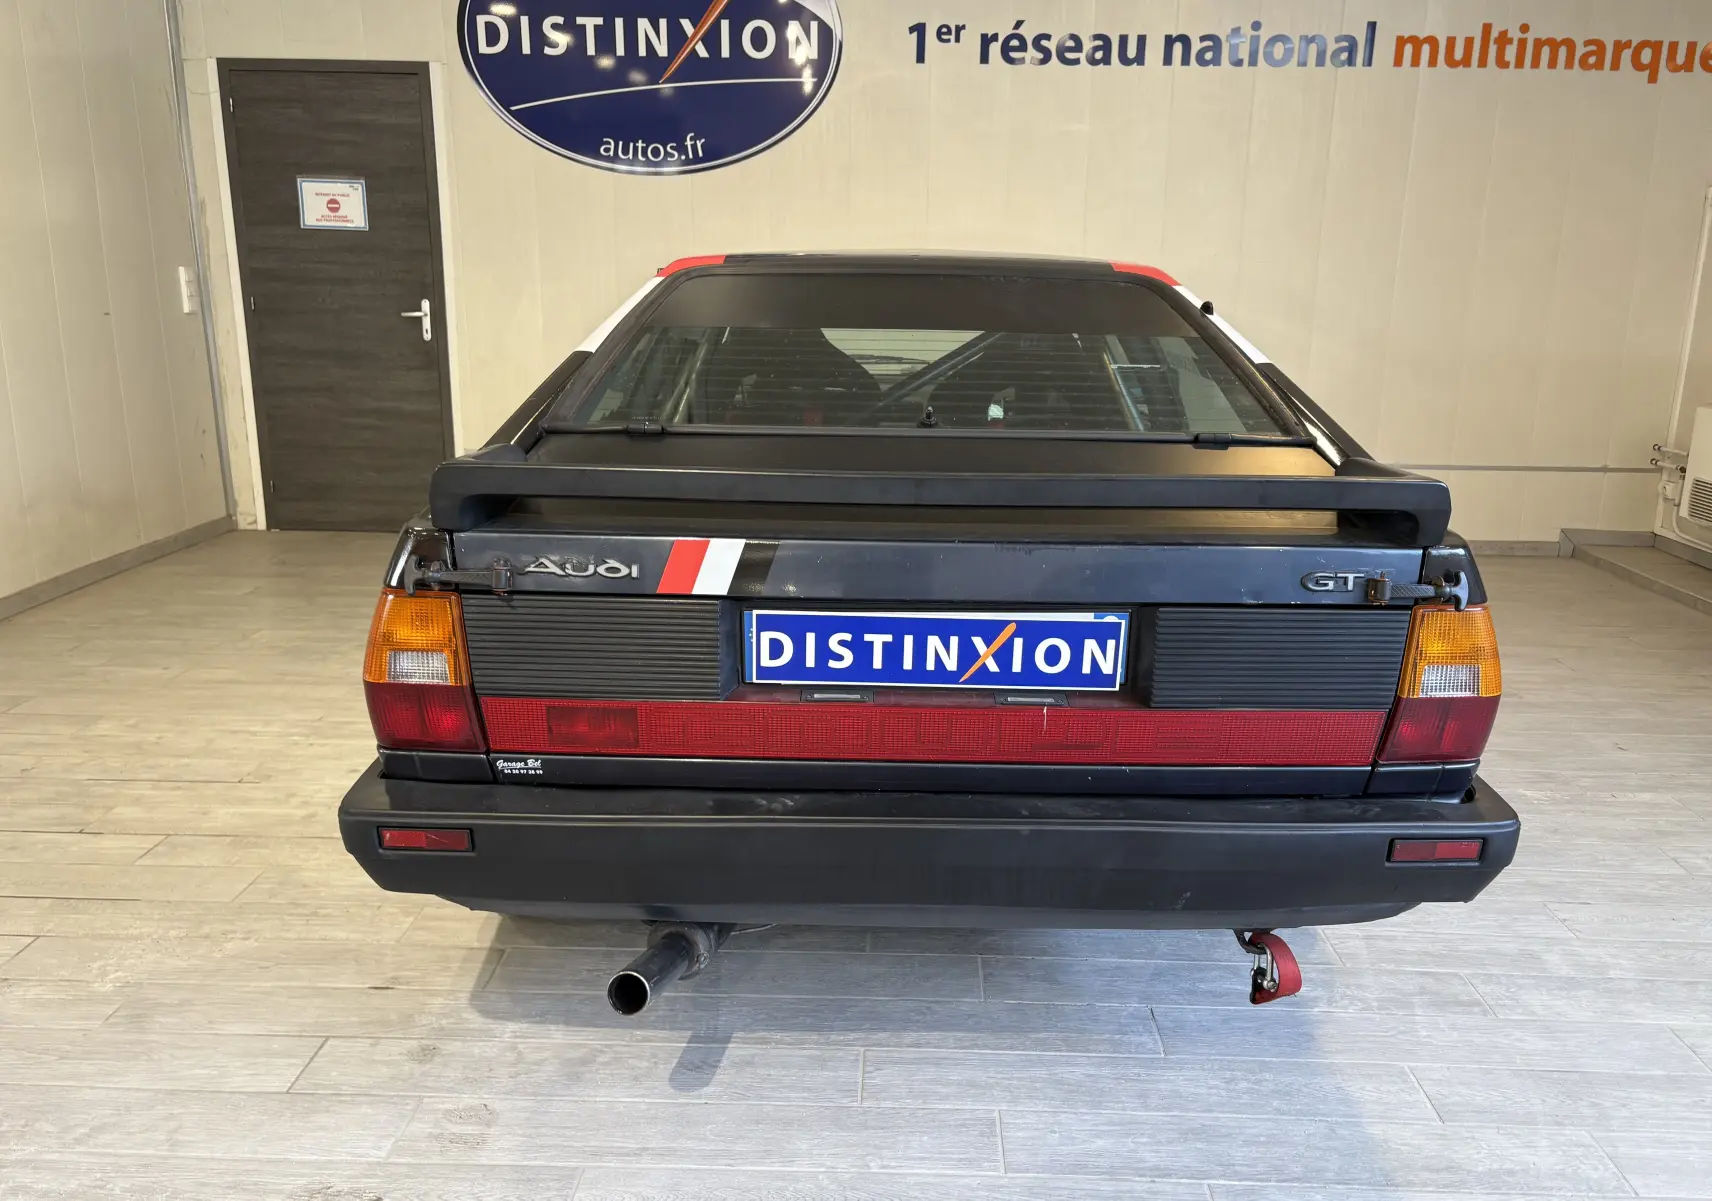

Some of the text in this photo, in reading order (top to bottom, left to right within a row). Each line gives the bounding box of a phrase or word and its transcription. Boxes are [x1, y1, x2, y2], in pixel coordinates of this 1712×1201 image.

[476, 14, 819, 61] DISTINXION
[908, 21, 966, 64] 1er
[979, 20, 1147, 67] réseau
[1163, 20, 1378, 68] national
[600, 133, 706, 162] autos.fr
[1303, 571, 1365, 592] GT
[759, 628, 1117, 677] DISTINXION
[496, 759, 525, 769] Garage
